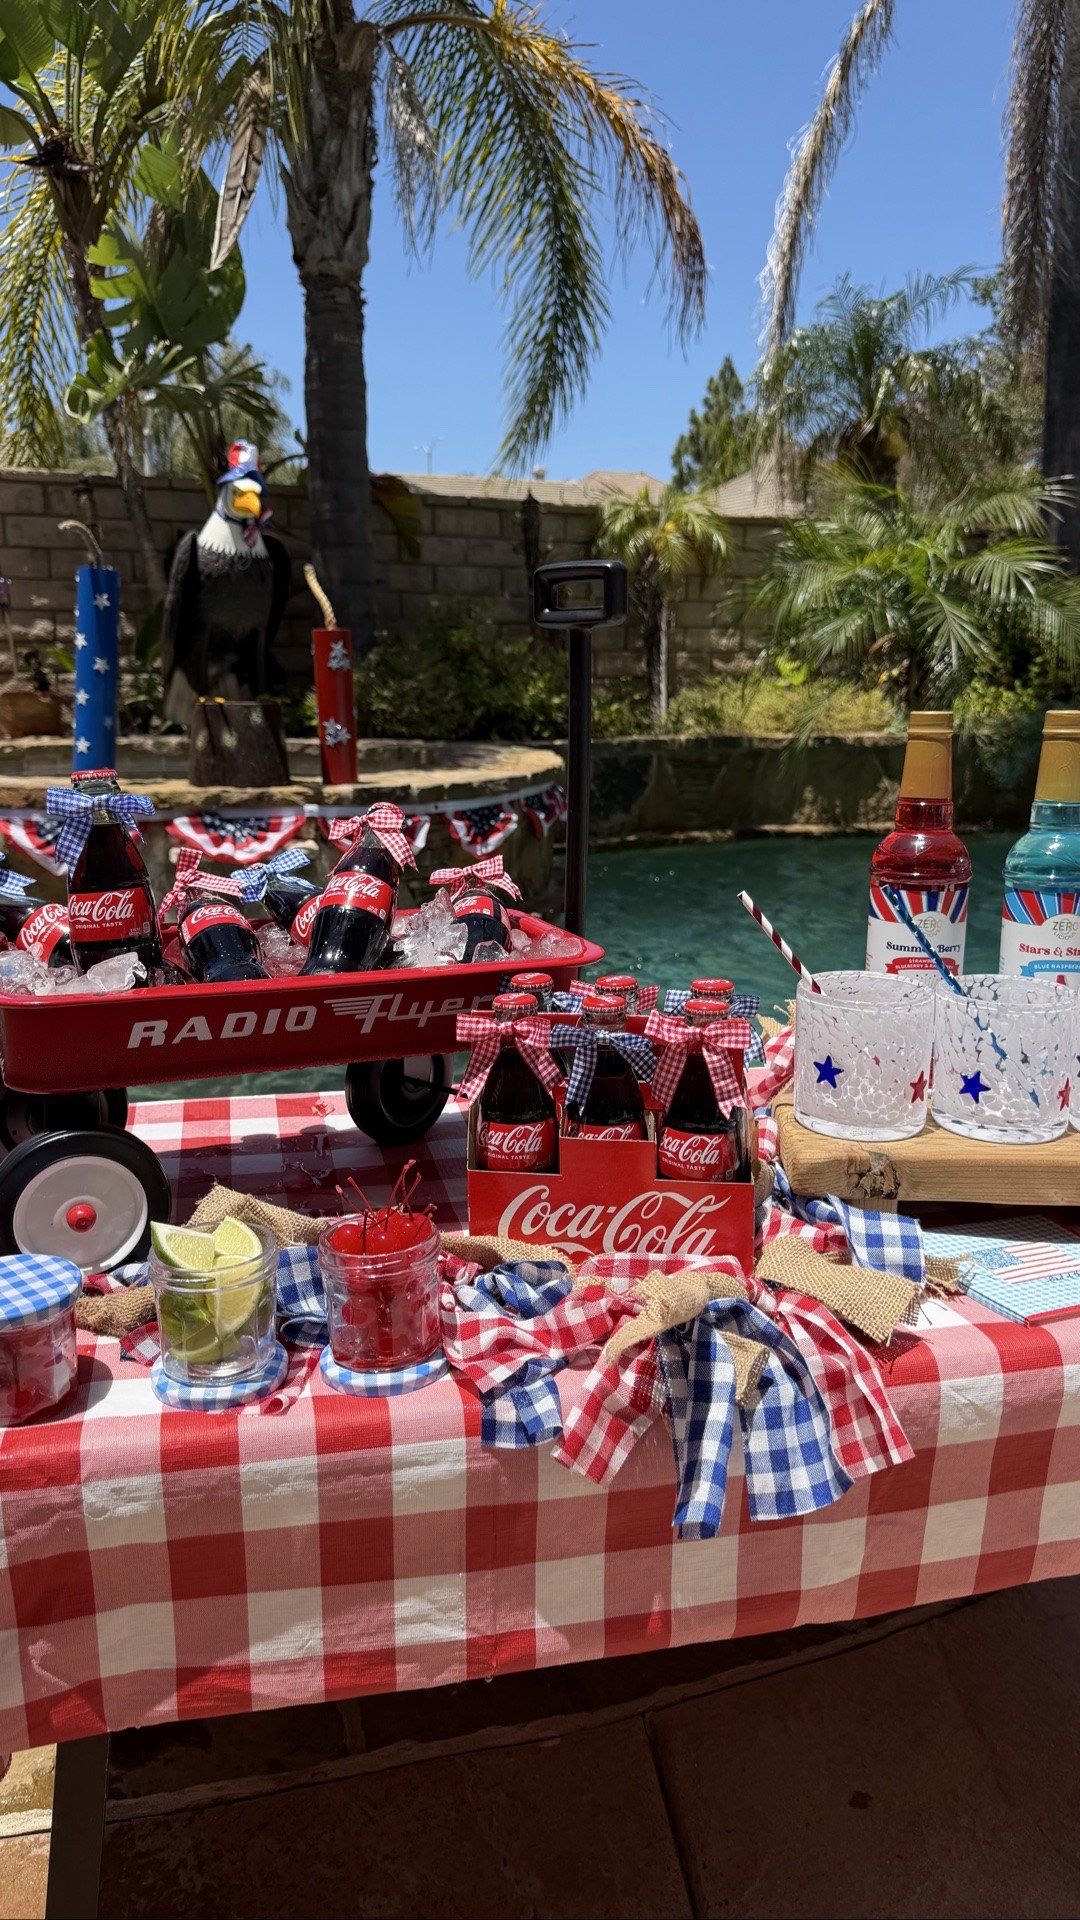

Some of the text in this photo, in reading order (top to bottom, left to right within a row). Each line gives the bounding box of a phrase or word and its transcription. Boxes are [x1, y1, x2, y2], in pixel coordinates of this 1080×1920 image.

[69, 890, 135, 922] Coca-Cola
[20, 903, 69, 951] Coca-Col
[918, 919, 943, 929] ZERO
[1052, 921, 1079, 932] ZERO
[886, 940, 961, 953] Summ Berry
[1019, 943, 1051, 956] Stars
[1053, 946, 1063, 957] &
[127, 992, 494, 1048] RADIO Flyer
[478, 1121, 546, 1154] Coca-Cola
[497, 1185, 732, 1256] Coca-Cola
